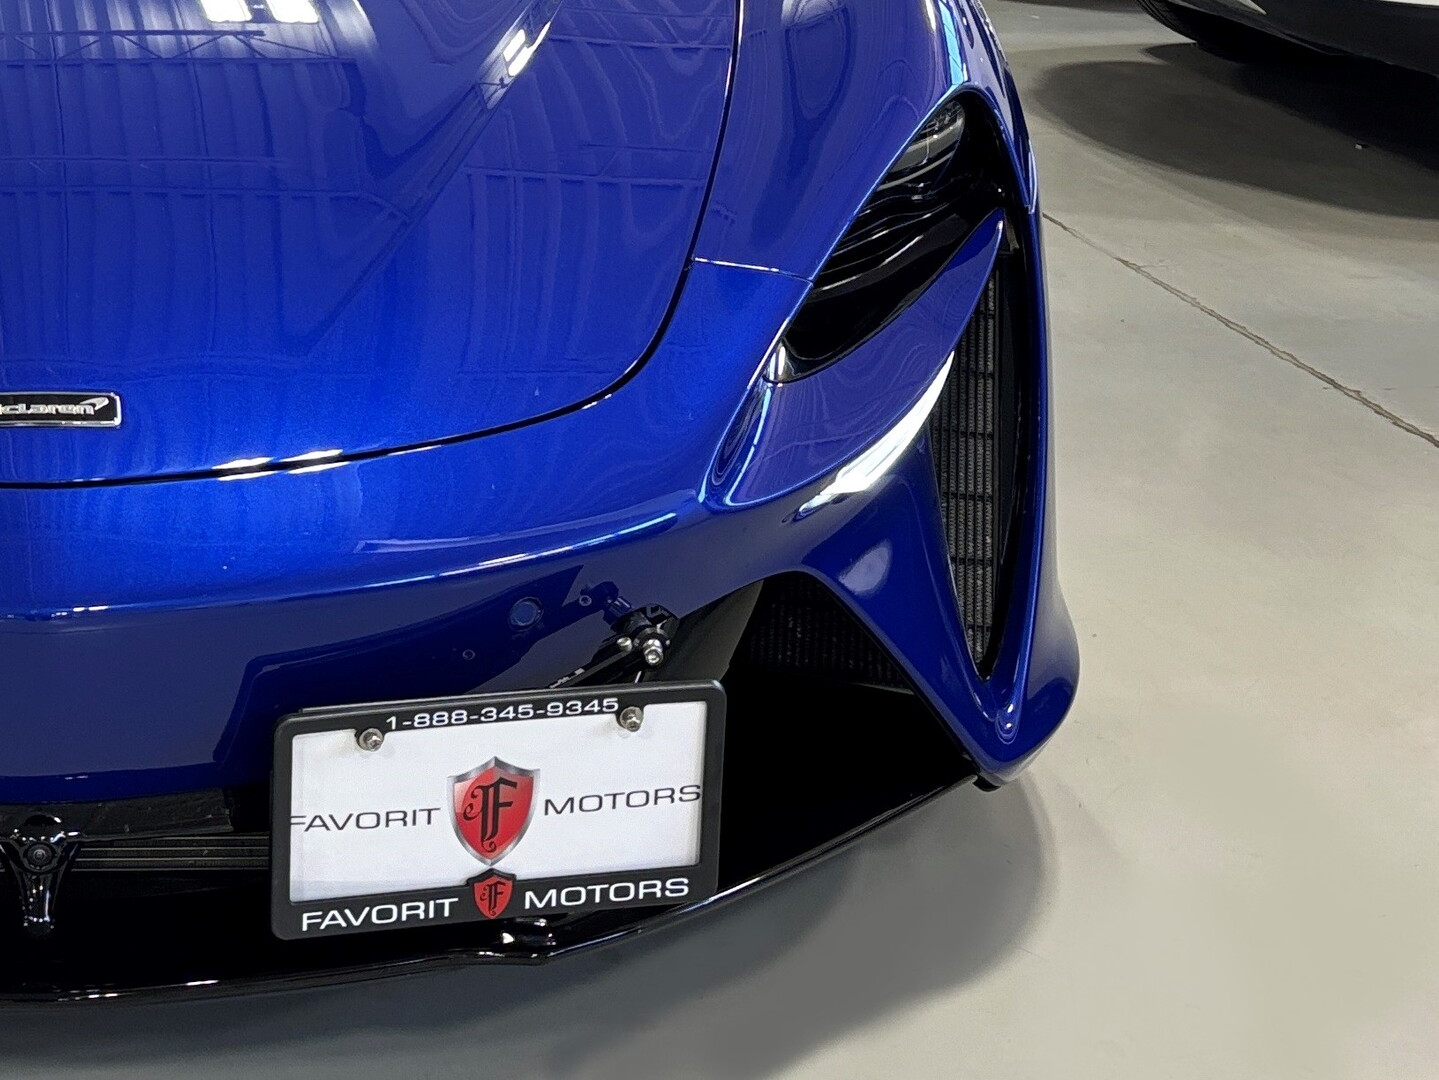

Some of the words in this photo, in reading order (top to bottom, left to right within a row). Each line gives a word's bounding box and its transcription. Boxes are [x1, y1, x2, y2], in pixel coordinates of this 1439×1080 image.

[385, 697, 619, 730] 1-888-345-9345
[543, 783, 702, 817] MOTORS
[301, 897, 459, 932] FAVORIT
[524, 877, 690, 910] MOTORS
